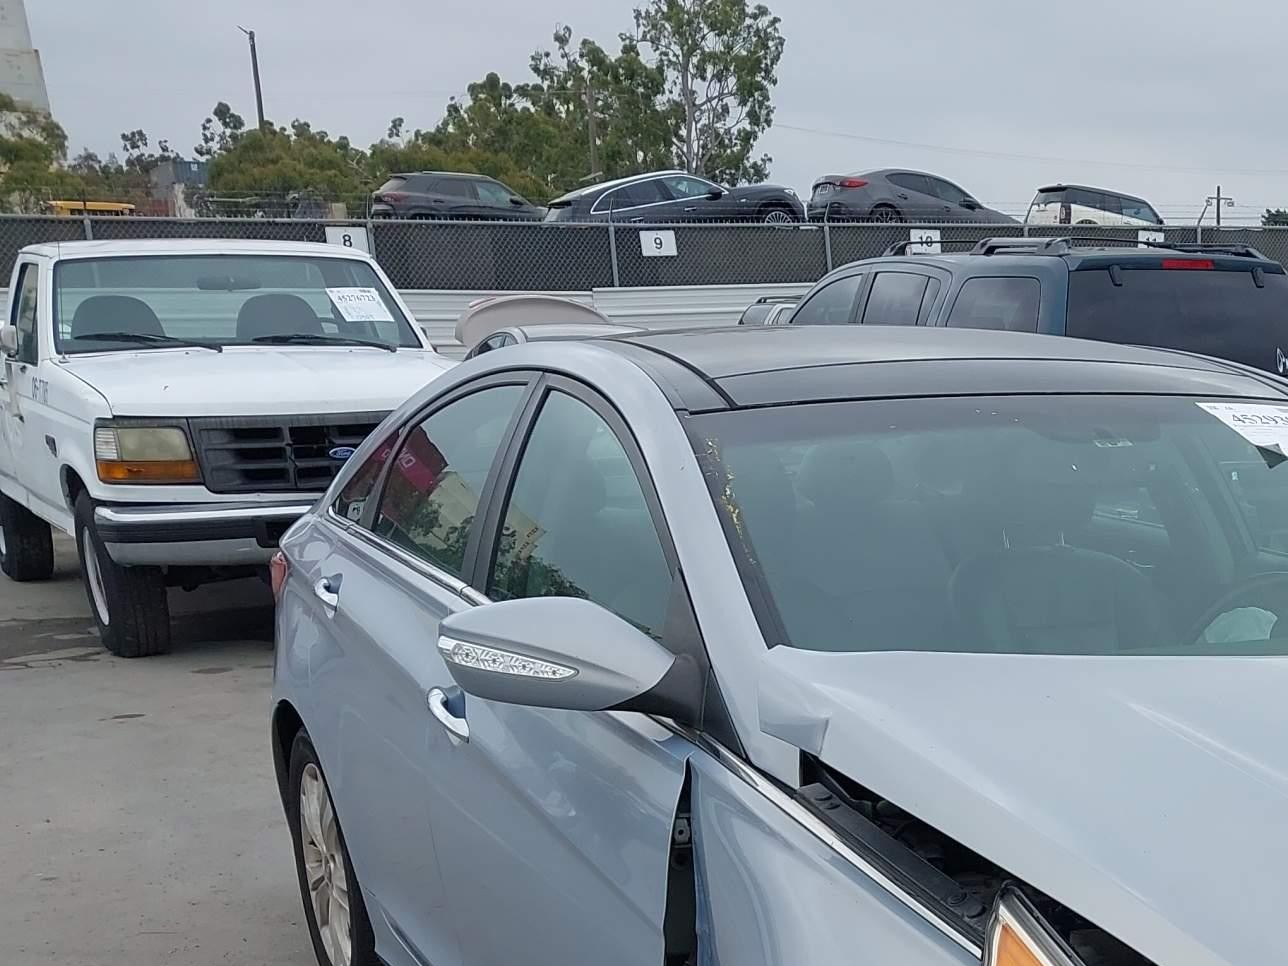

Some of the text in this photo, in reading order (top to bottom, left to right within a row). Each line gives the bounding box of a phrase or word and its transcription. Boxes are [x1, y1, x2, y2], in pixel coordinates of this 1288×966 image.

[342, 234, 353, 248] 8
[653, 236, 663, 250] 9
[918, 235, 933, 248] 10
